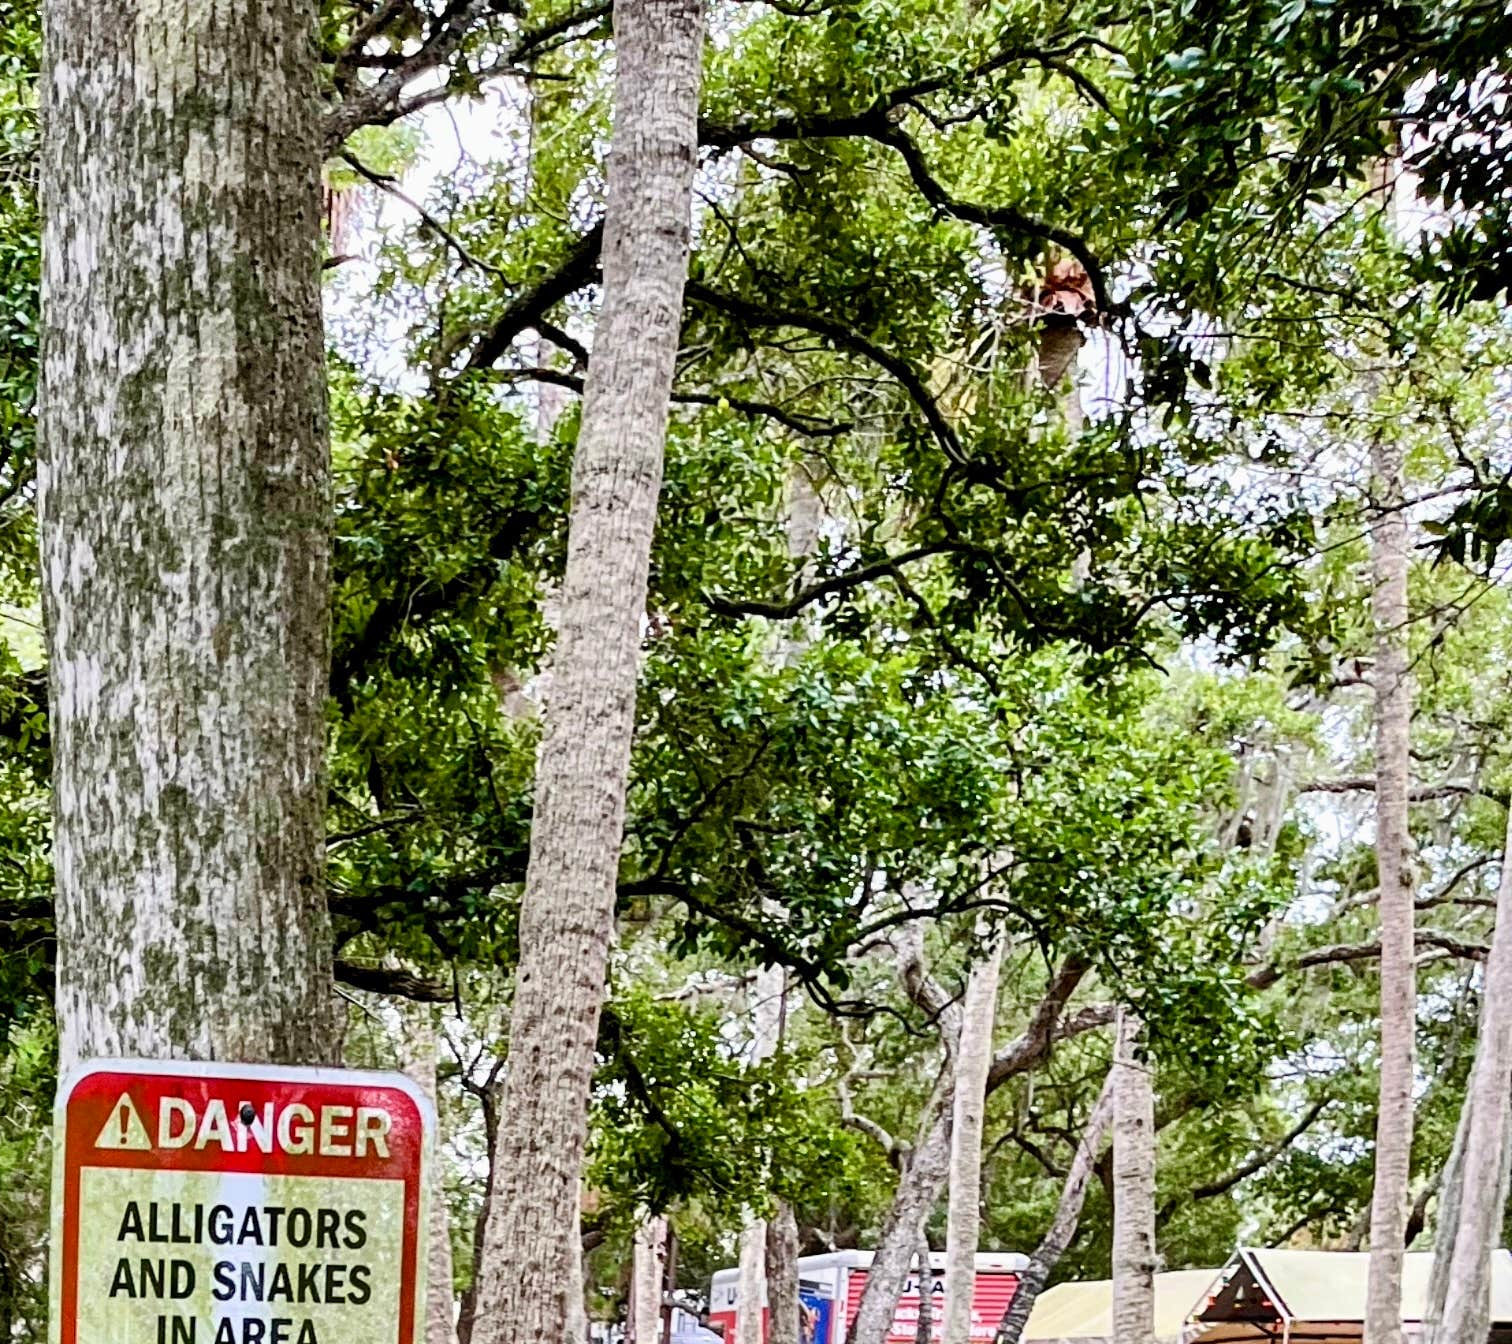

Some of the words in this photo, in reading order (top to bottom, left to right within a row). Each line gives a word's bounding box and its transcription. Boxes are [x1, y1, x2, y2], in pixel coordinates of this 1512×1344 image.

[158, 1096, 392, 1158] DANGER
[117, 1201, 367, 1249] ALLIGATORS
[109, 1258, 195, 1299] AND
[212, 1262, 371, 1304] SNAKES
